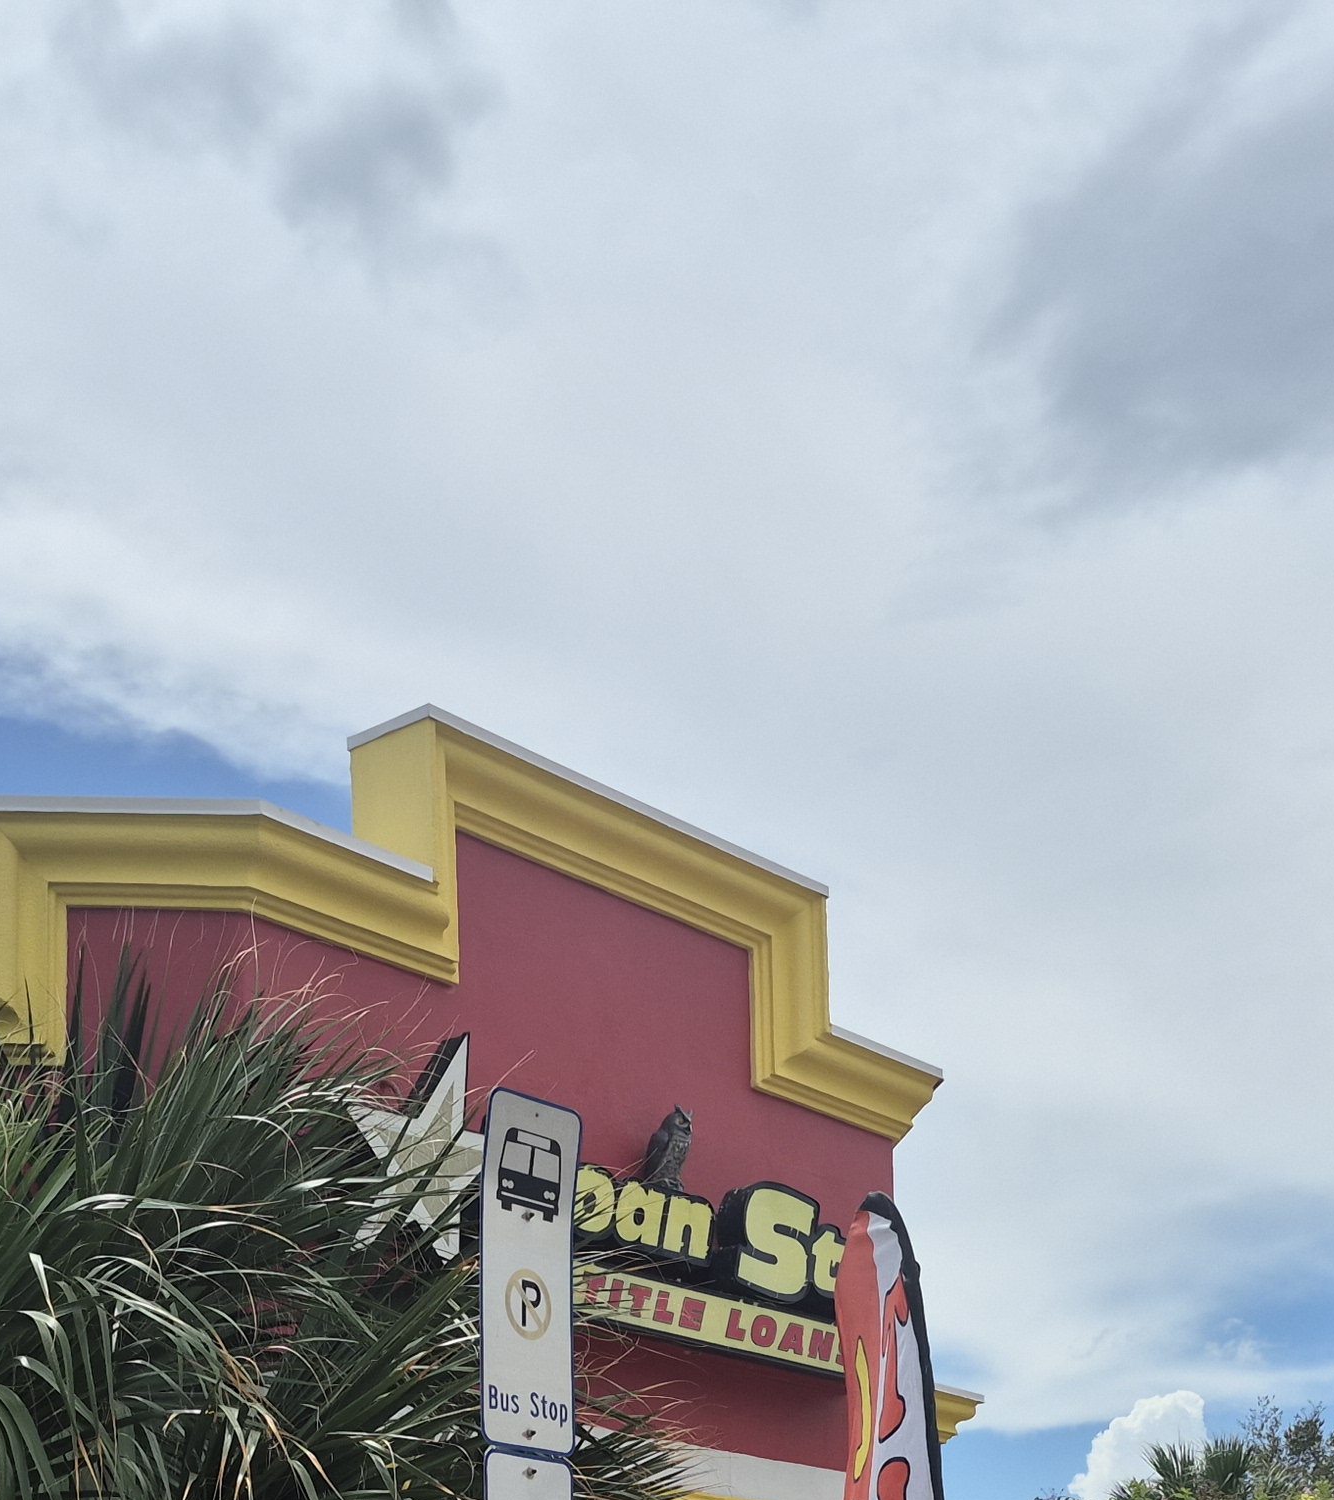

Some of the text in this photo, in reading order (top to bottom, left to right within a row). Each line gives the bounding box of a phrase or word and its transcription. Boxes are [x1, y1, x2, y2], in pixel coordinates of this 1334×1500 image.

[574, 1165, 846, 1295] oan St
[583, 1271, 845, 1366] TITLE LOAN
[488, 1384, 567, 1428] Bus Stop
